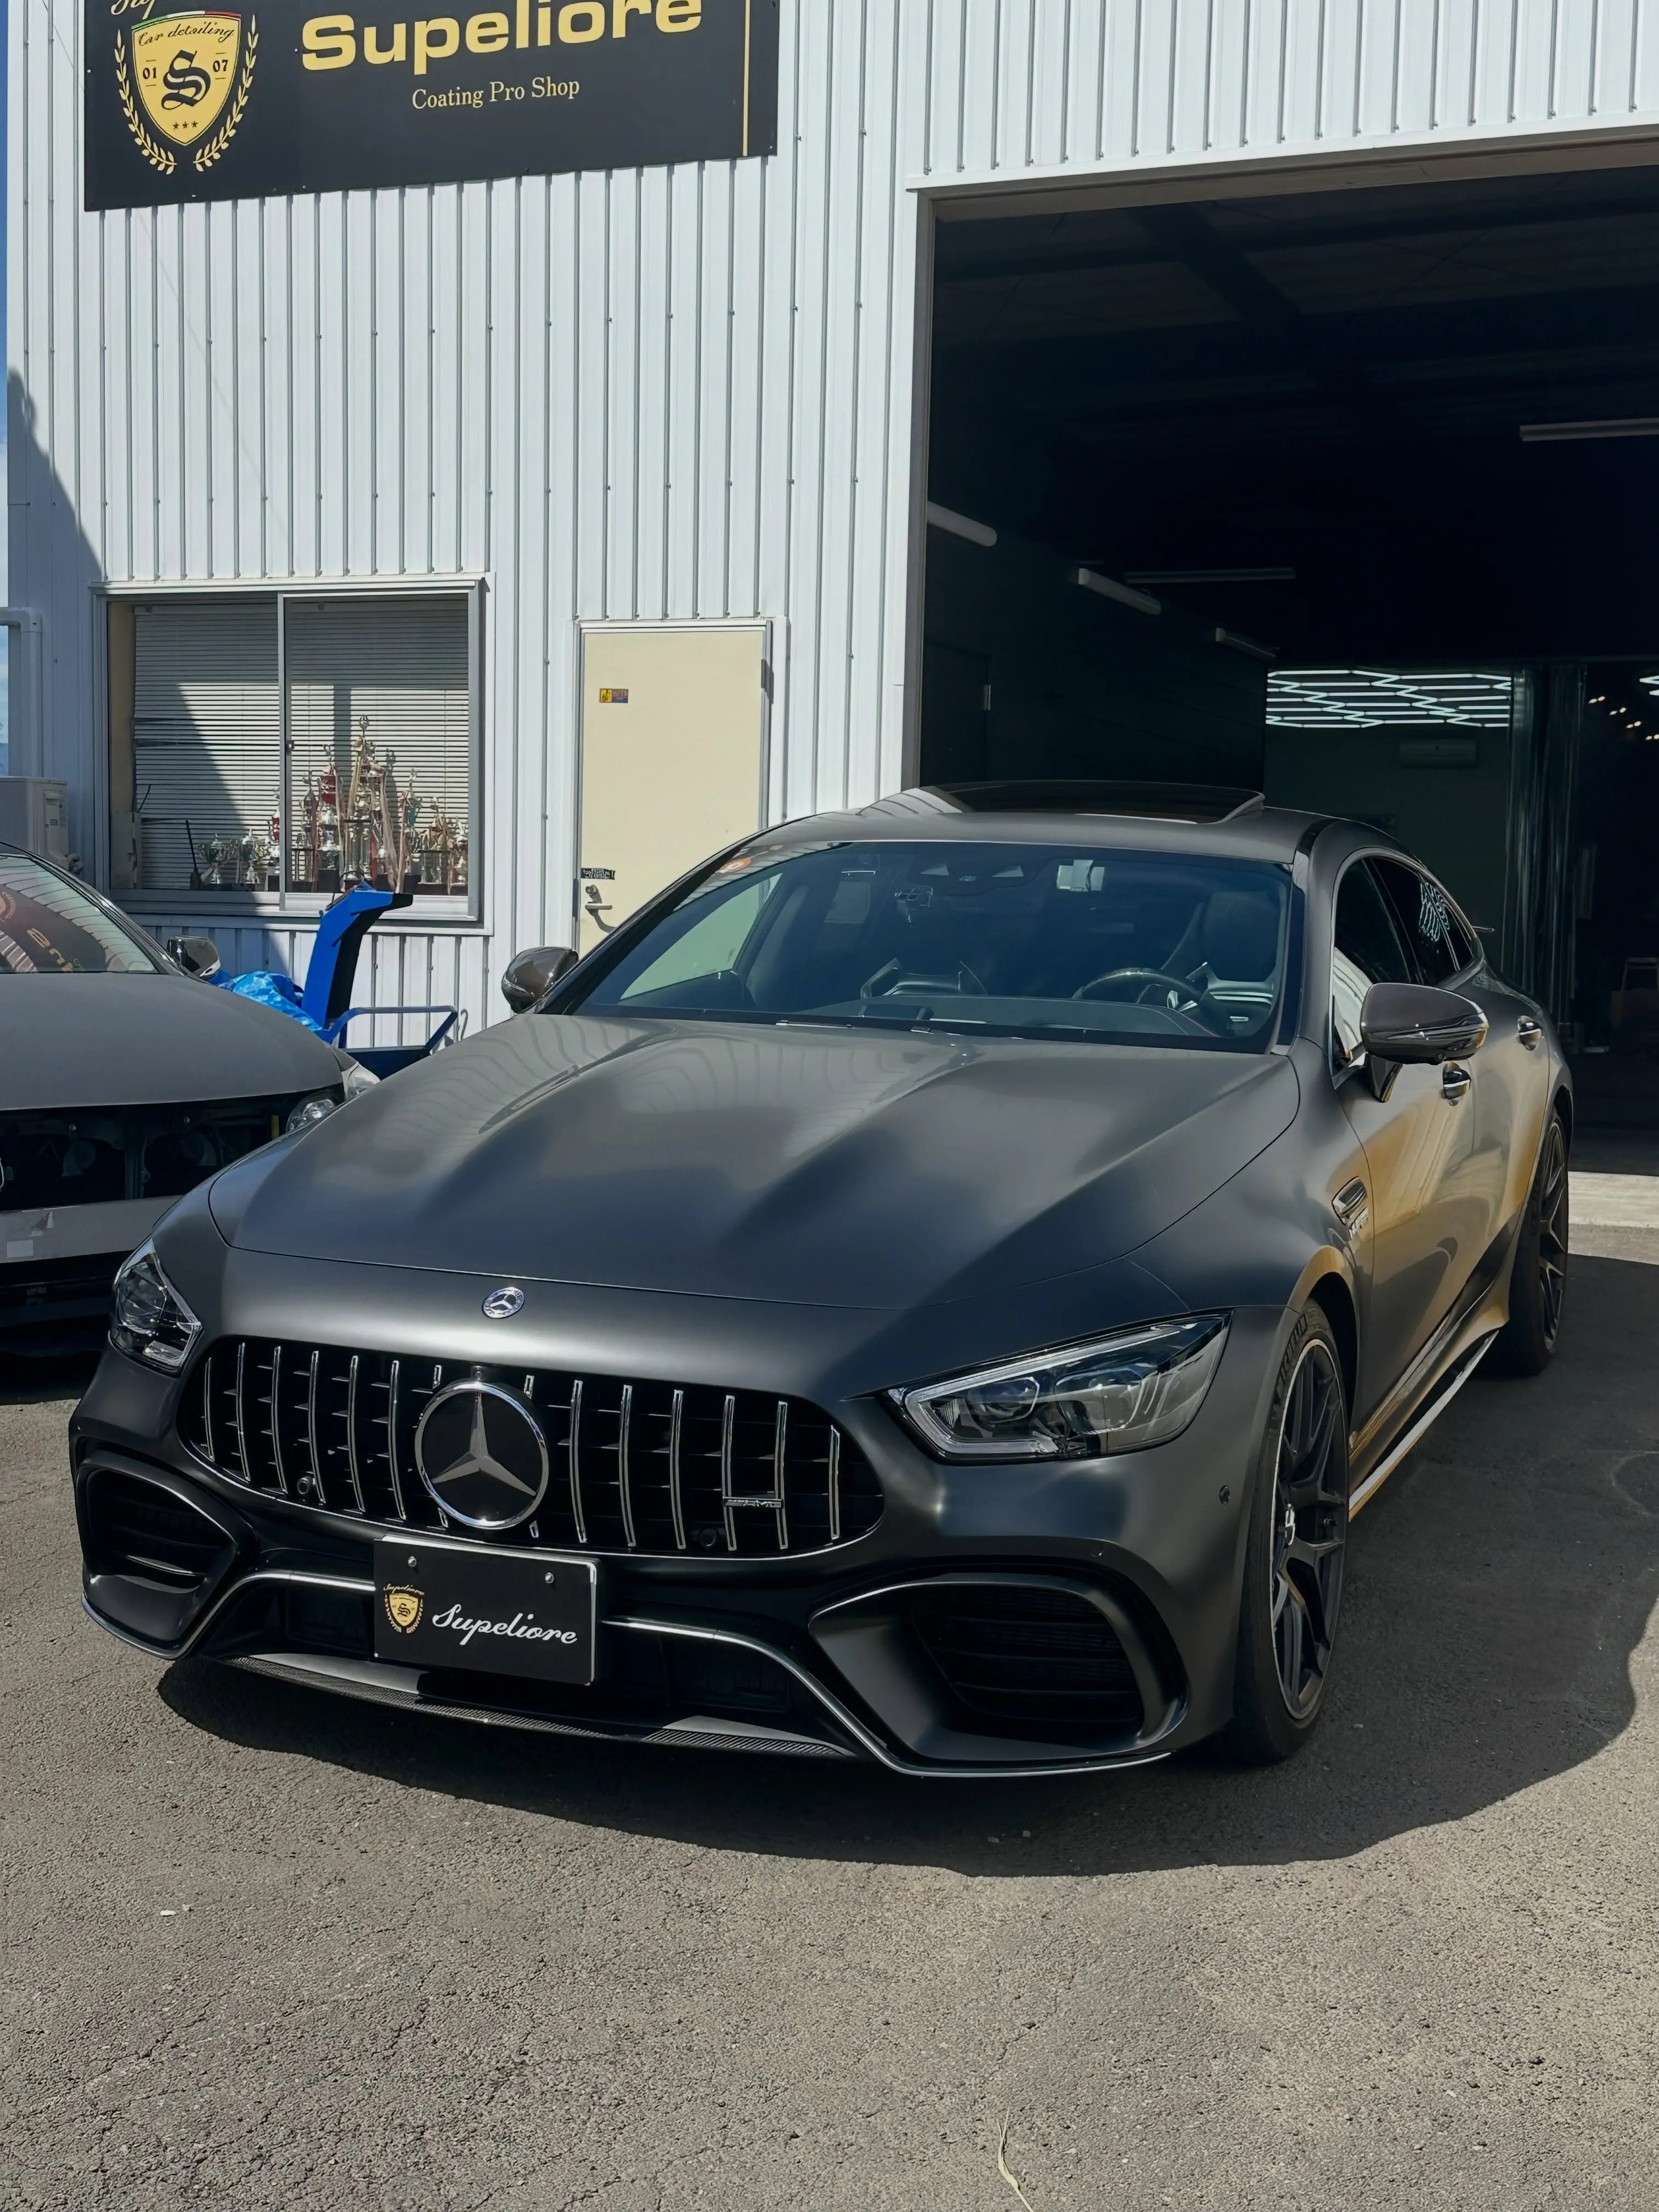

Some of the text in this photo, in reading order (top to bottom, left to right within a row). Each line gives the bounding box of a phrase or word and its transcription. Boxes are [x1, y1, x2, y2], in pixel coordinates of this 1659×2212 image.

[138, 22, 235, 46] Car detailing
[302, 0, 702, 75] Supeliore
[143, 67, 156, 80] 01
[213, 59, 228, 72] 07
[412, 76, 580, 109] Coating Pro Shop
[432, 1604, 578, 1645] Supeliore
